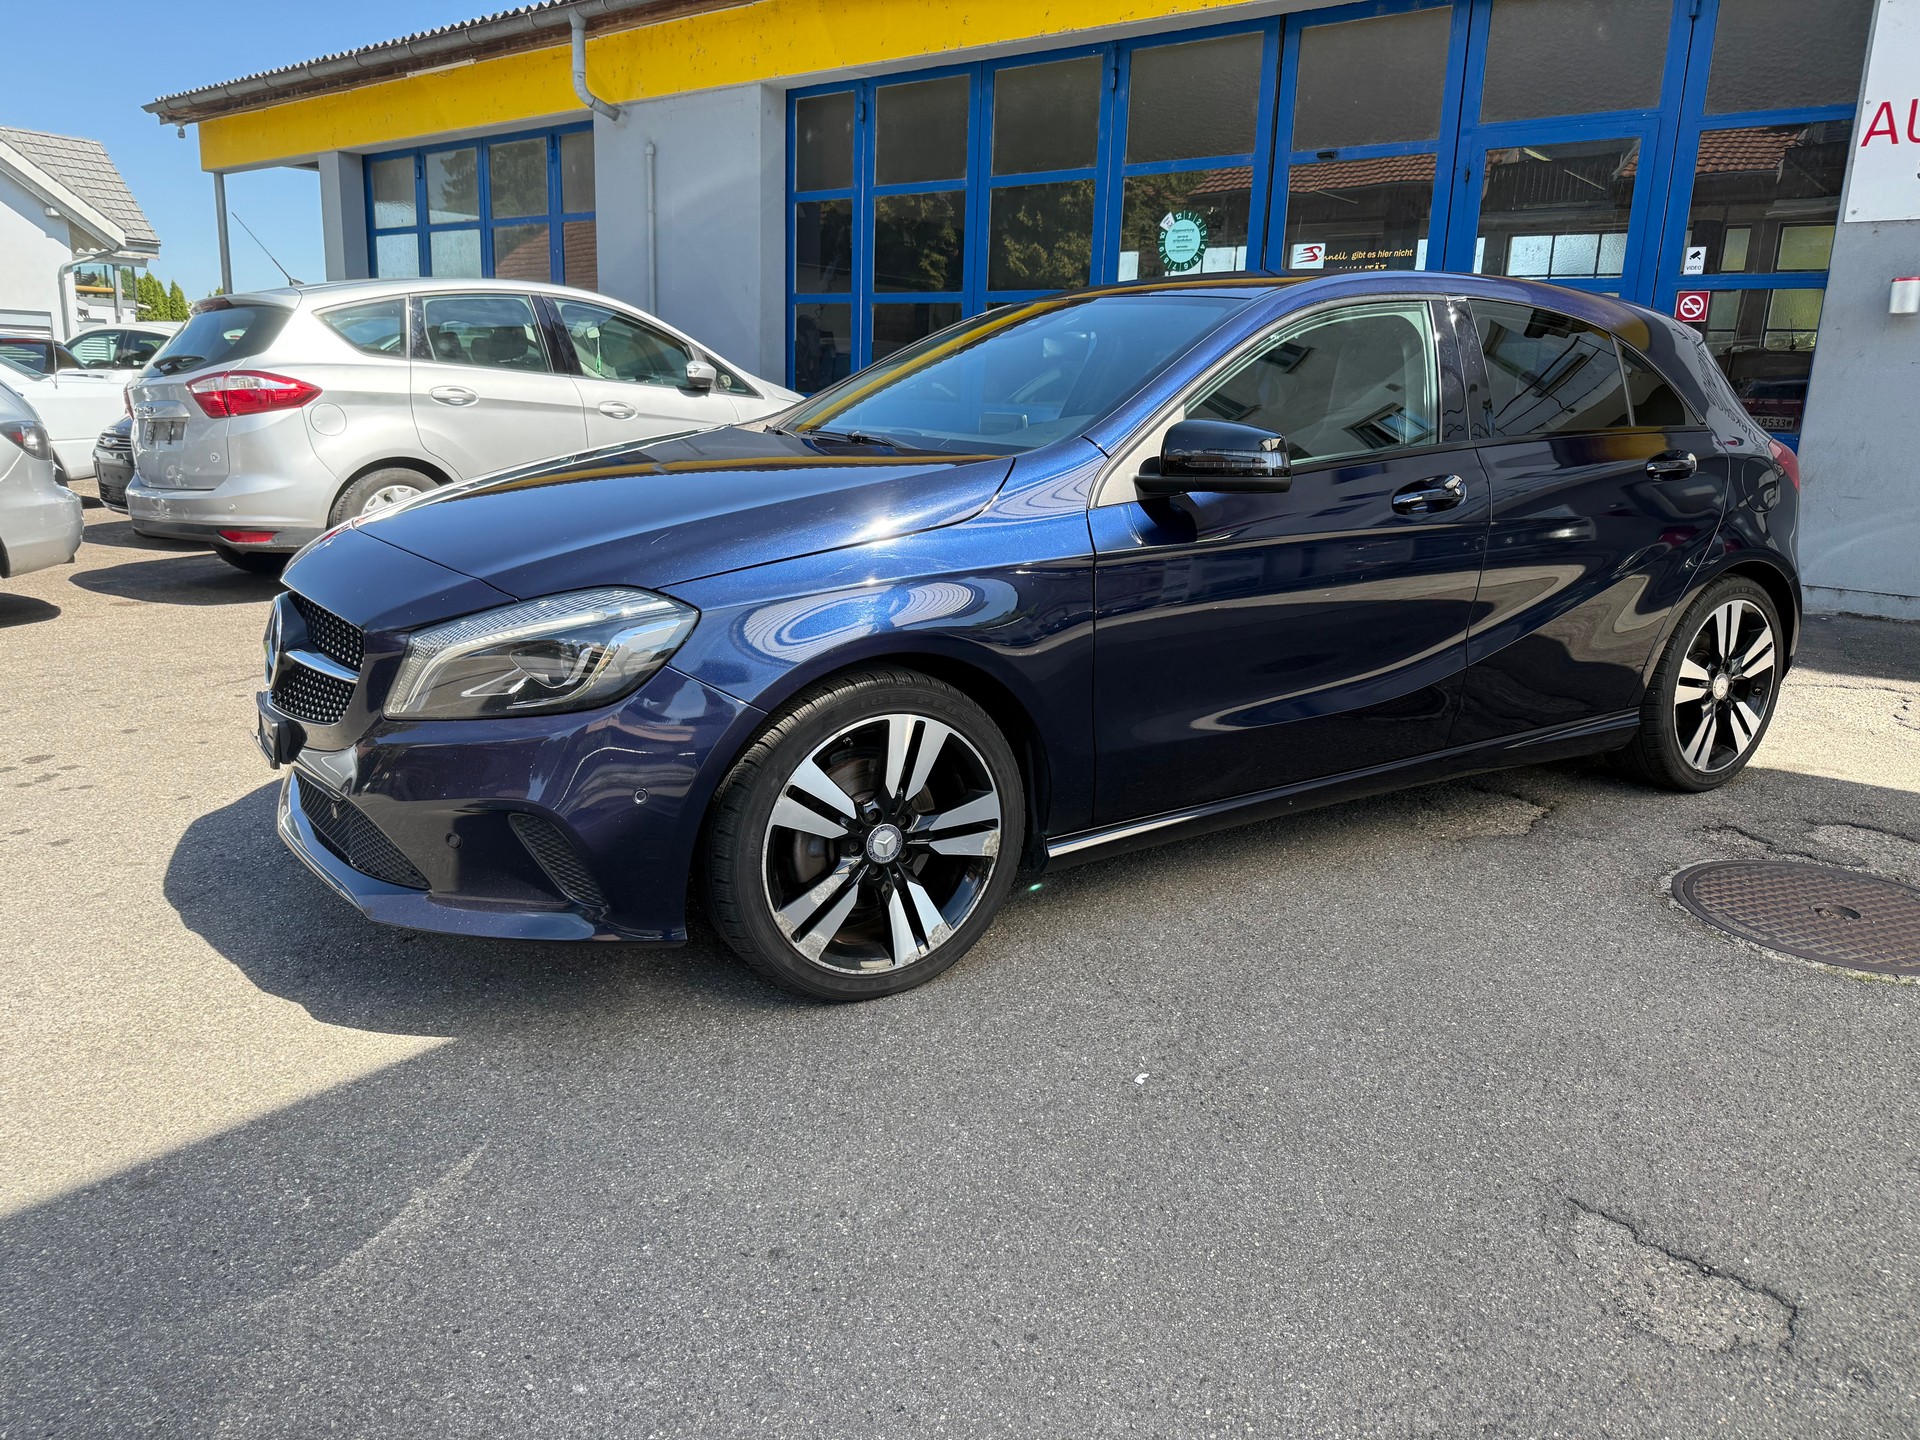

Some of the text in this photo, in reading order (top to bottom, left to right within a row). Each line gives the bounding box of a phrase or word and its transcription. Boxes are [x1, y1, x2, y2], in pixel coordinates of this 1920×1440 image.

[1175, 212, 1183, 220] 12
[1196, 218, 1202, 226] 2
[1159, 231, 1166, 240] 10
[1351, 251, 1366, 261] gibt
[1367, 251, 1376, 259] es
[1377, 249, 1392, 259] hier
[1393, 248, 1413, 258] nicht
[1183, 262, 1189, 270] 6
